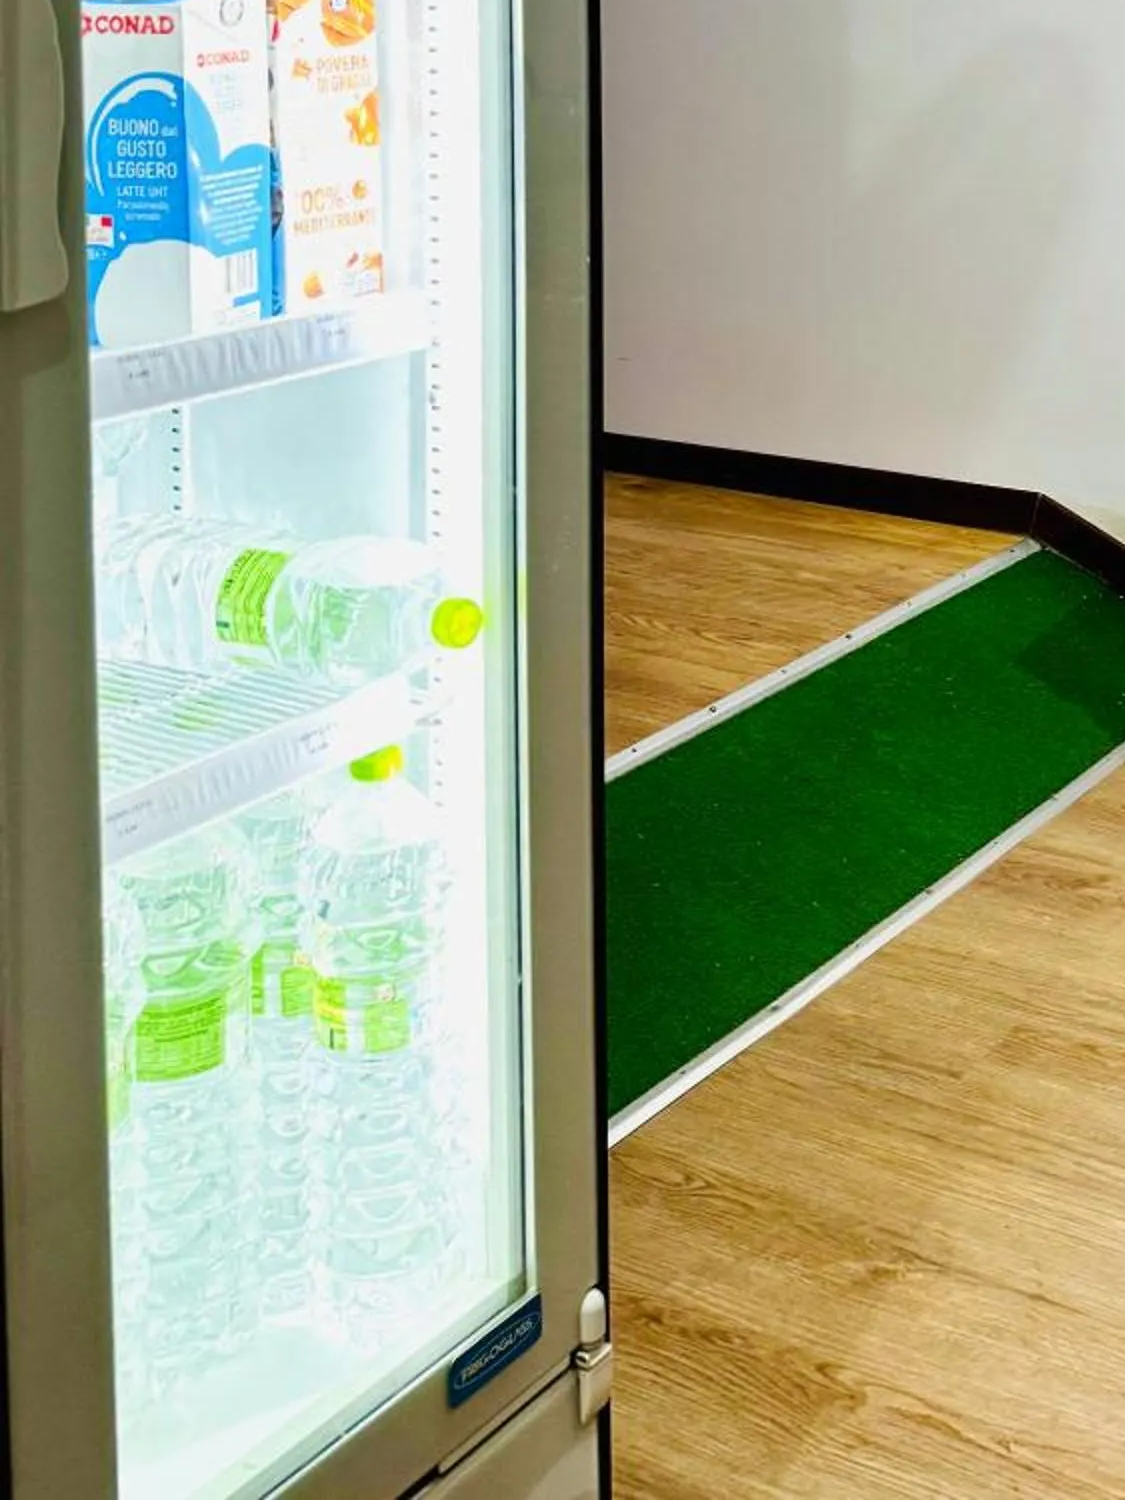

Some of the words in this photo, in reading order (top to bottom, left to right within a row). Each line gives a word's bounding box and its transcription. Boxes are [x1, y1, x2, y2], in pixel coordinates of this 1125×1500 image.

[94, 15, 175, 34] CONAD
[206, 49, 250, 66] CONAD
[108, 118, 159, 136] BUONO
[116, 140, 167, 157] GUSTO
[107, 161, 178, 179] LEGGERO
[116, 186, 146, 197] LATTE
[298, 184, 346, 214] 00%
